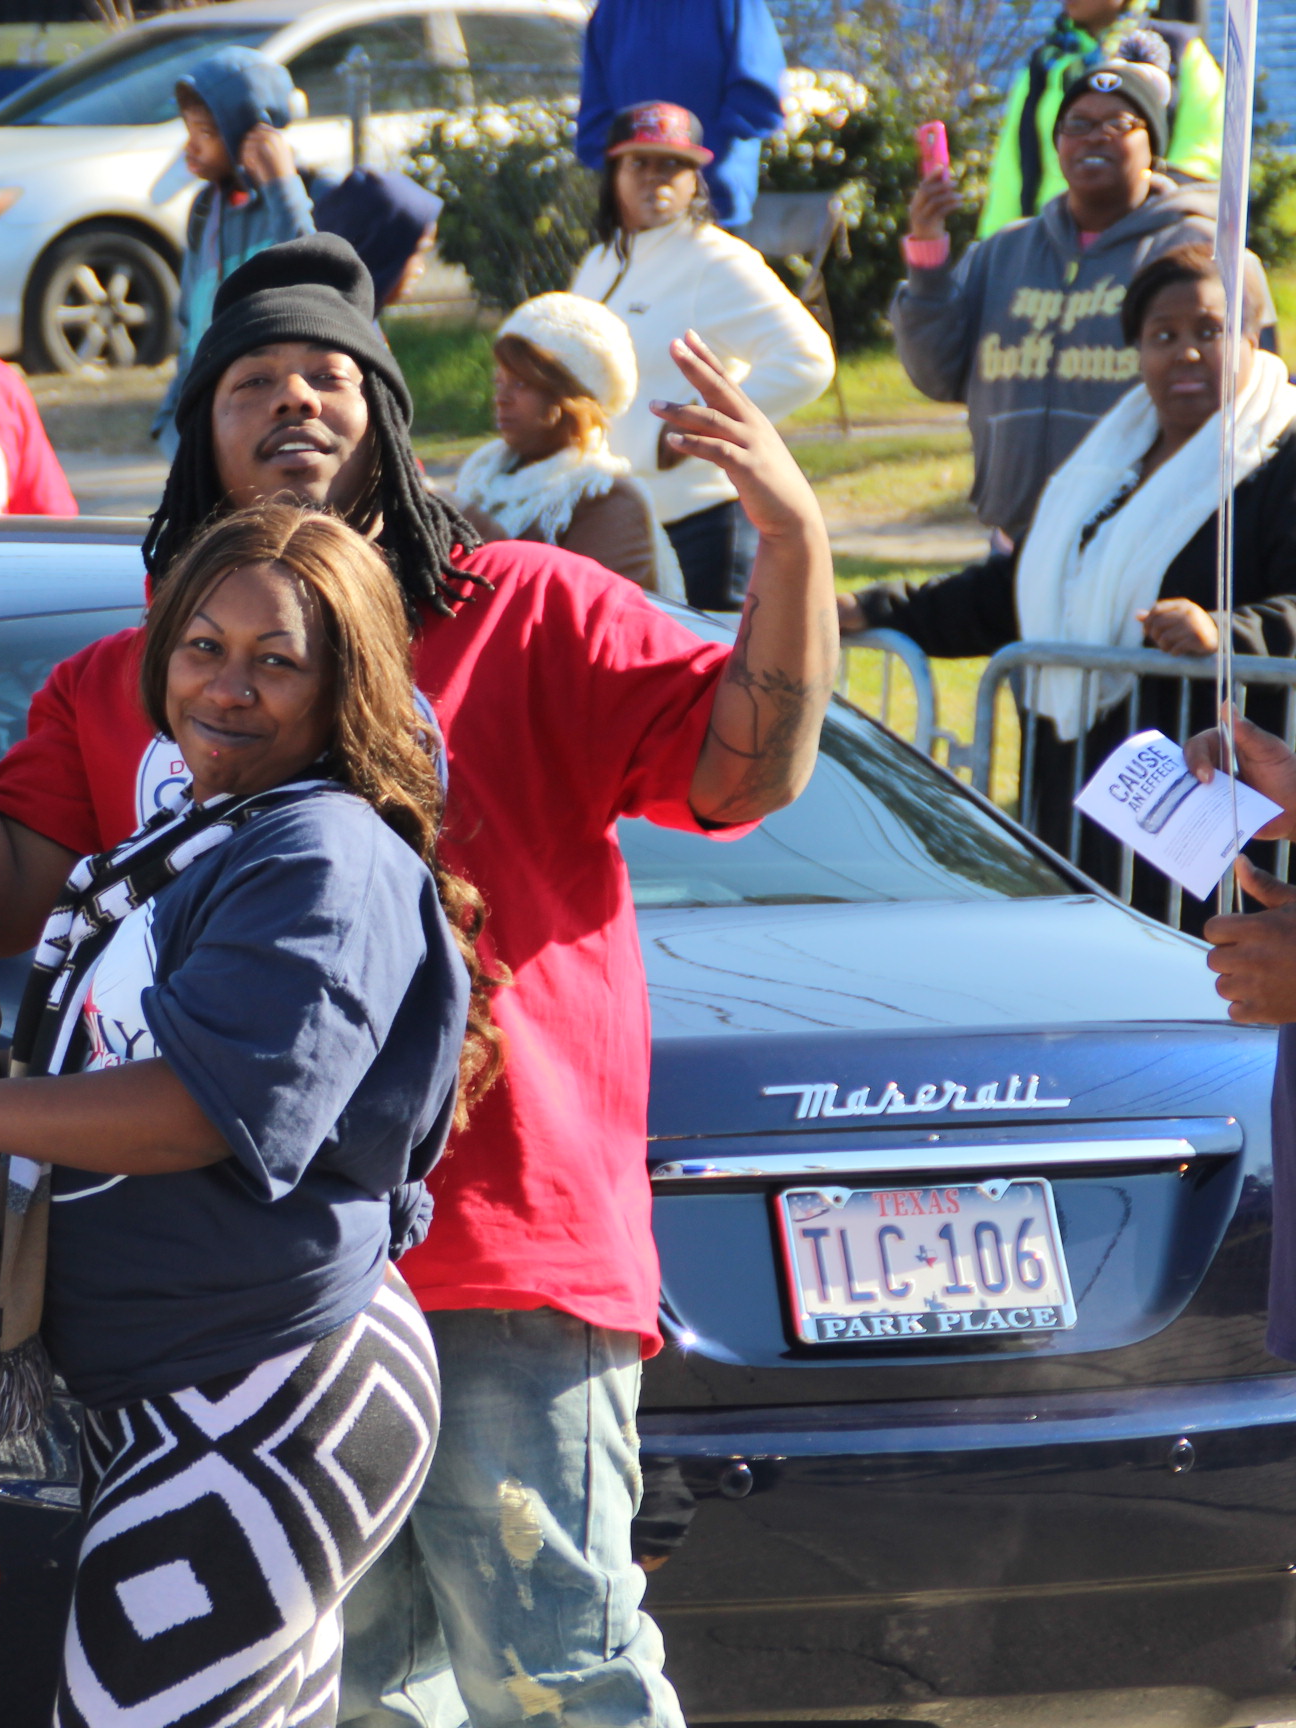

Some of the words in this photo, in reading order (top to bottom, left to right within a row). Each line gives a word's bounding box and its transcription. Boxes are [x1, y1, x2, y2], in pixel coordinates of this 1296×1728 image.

[1109, 745, 1170, 803] CAUSE
[1128, 794, 1144, 813] AN
[1141, 758, 1179, 796] EFFECT
[761, 1074, 1071, 1119] Maserati
[873, 1189, 961, 1218] TEXAS
[799, 1224, 916, 1304] TLC
[938, 1217, 1049, 1296] 106
[822, 1313, 927, 1340] PARK
[937, 1306, 1058, 1334] PLACE
